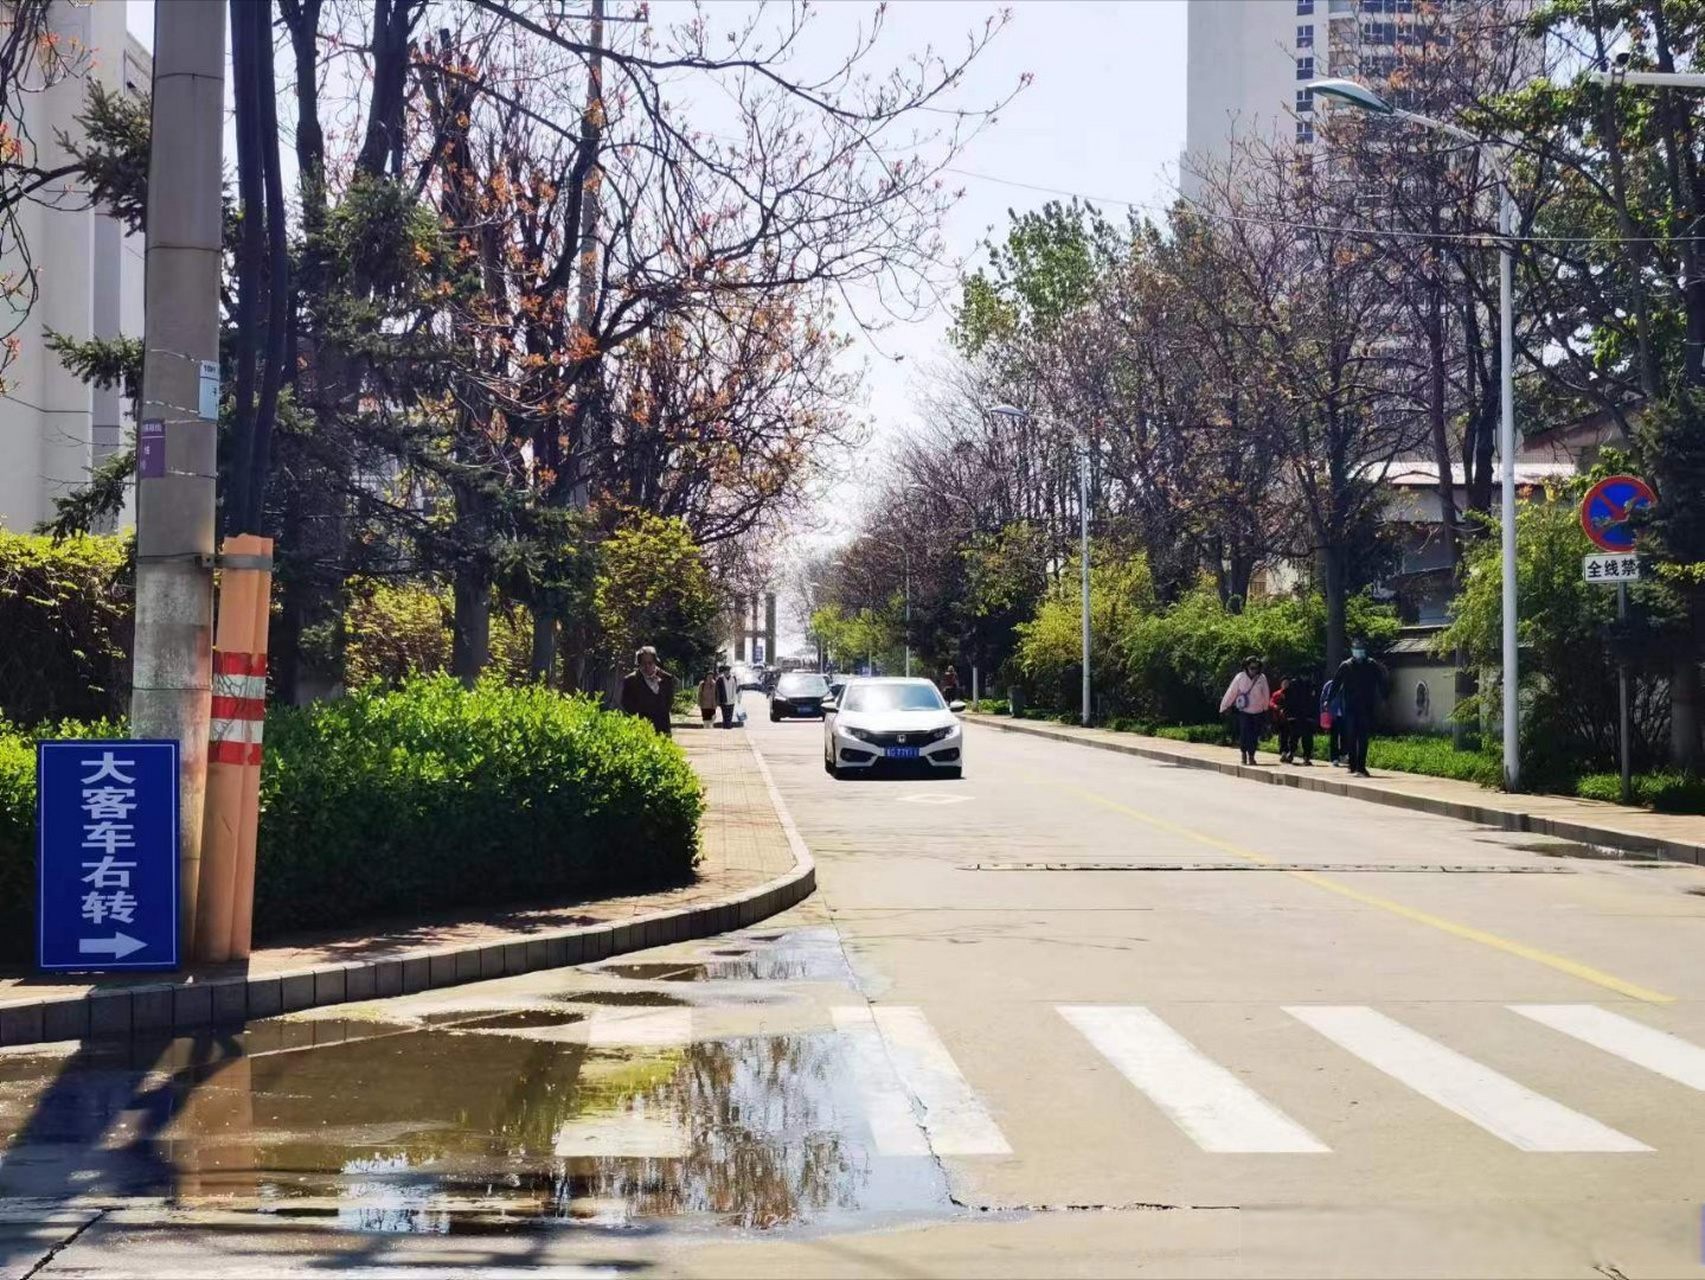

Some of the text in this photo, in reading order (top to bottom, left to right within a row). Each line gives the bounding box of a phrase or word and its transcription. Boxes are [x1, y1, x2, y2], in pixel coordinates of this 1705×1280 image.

[81, 752, 137, 924] 大客车右转
